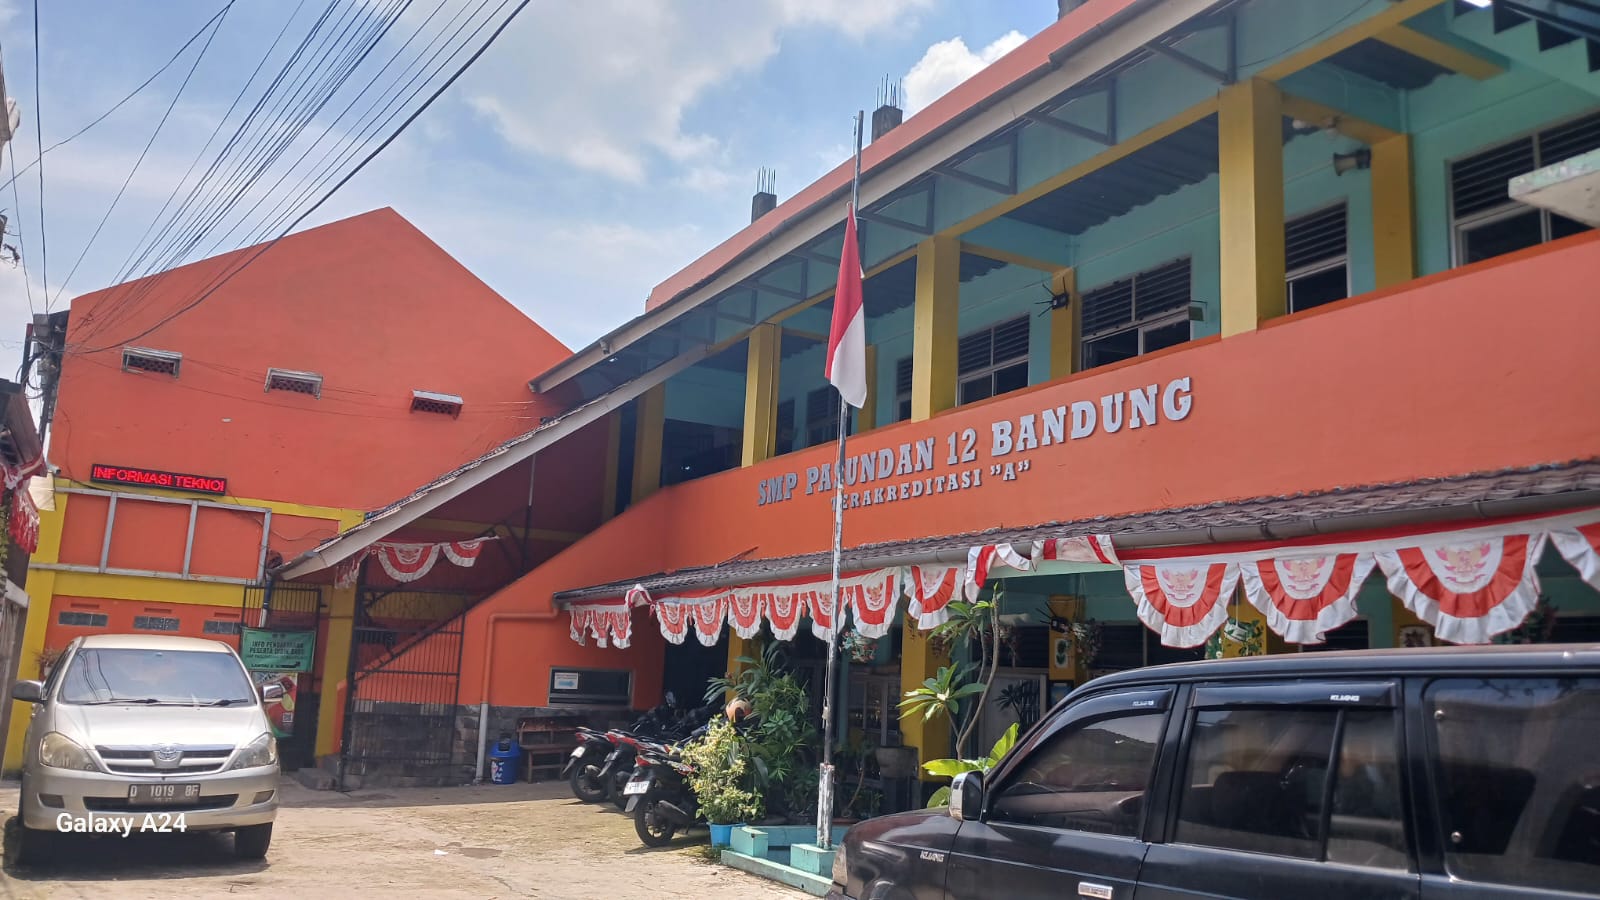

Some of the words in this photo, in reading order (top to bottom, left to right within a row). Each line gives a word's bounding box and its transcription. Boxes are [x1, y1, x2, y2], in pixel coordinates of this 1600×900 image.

[757, 473, 798, 505] SMP
[946, 428, 977, 465] 12
[990, 377, 1192, 457] BANDUNG
[93, 466, 171, 486] INFORMASI
[130, 785, 138, 797] D
[150, 785, 175, 797] 1019
